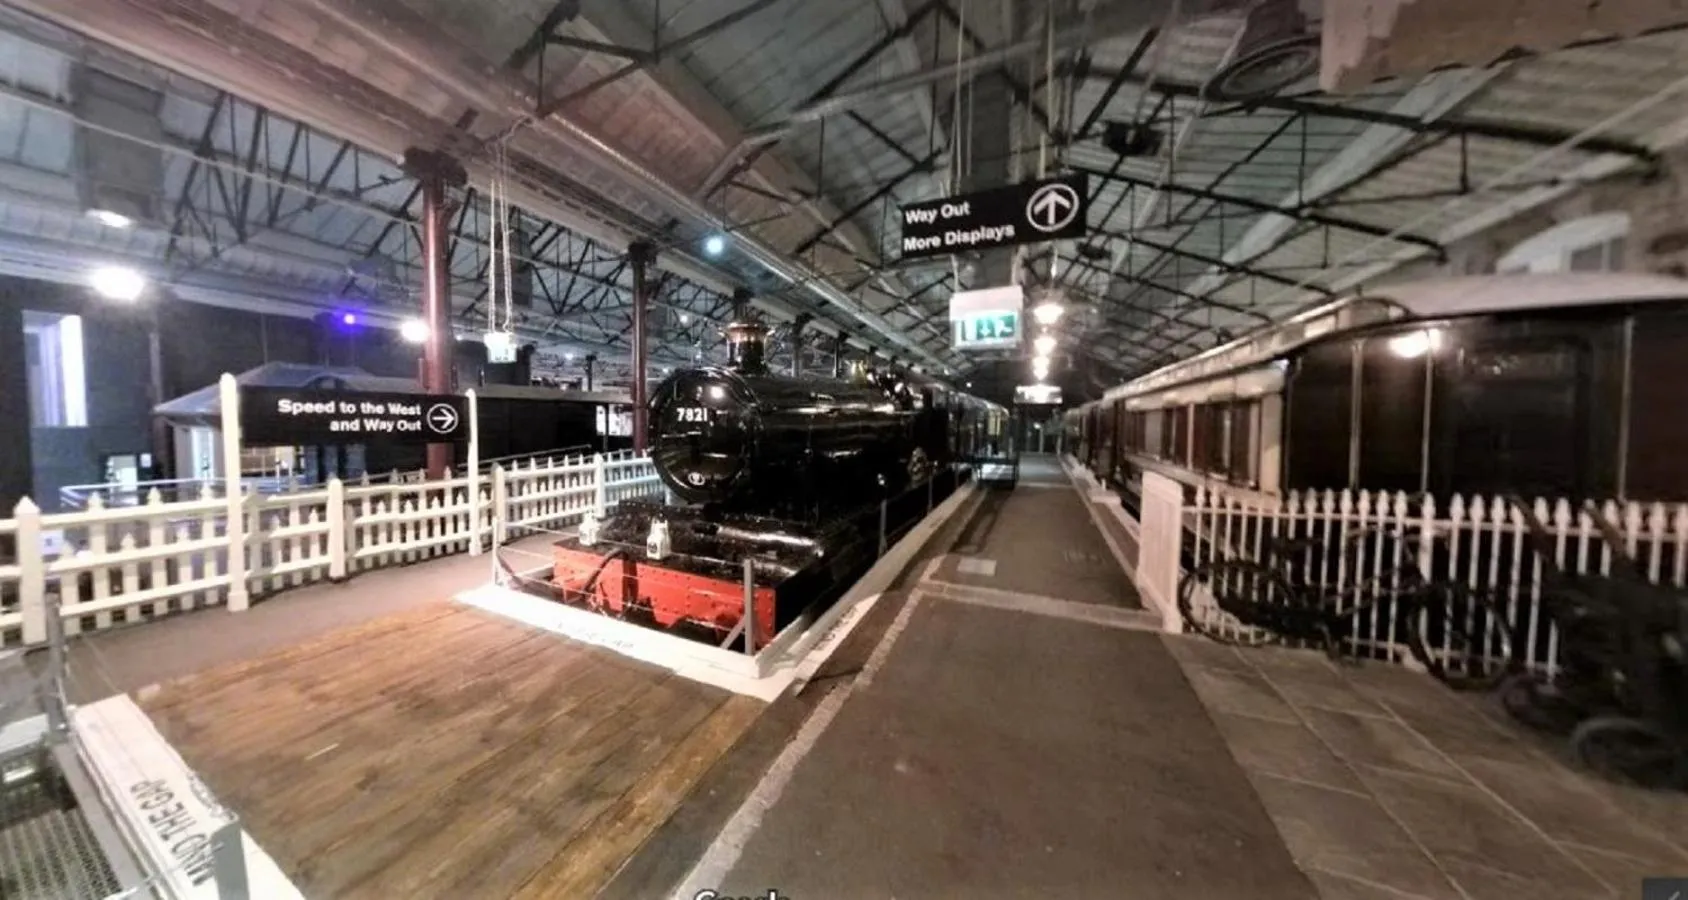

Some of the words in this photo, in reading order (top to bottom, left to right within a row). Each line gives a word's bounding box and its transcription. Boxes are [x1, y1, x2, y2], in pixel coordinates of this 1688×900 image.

[905, 208, 938, 224] Way
[940, 202, 971, 219] Out
[903, 235, 942, 252] More
[944, 224, 1016, 246] Displays
[277, 398, 336, 416] Speed
[339, 402, 356, 414] to
[360, 402, 385, 414] the
[388, 403, 422, 416] West
[676, 407, 708, 422] 7821
[330, 419, 360, 432] and
[363, 418, 394, 433] Way
[397, 419, 422, 432] Out
[130, 779, 174, 811] GAP
[148, 802, 198, 841] THE
